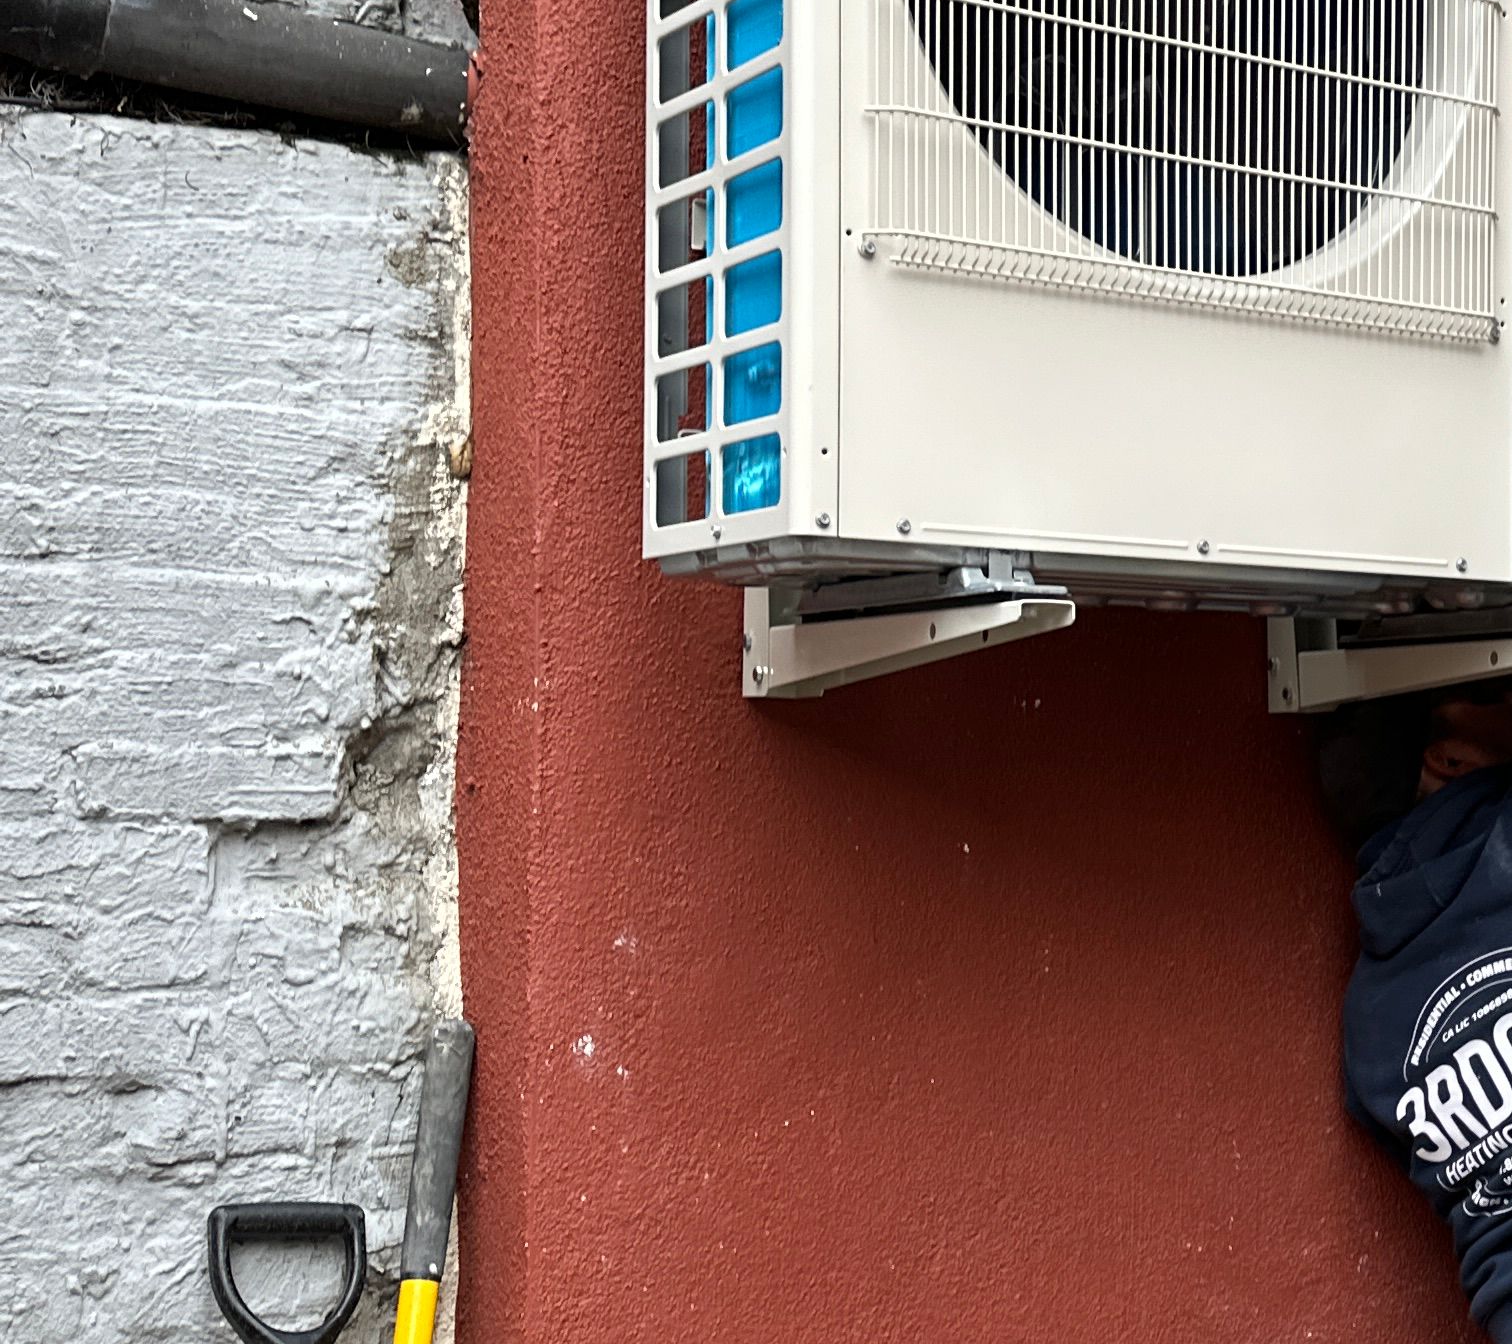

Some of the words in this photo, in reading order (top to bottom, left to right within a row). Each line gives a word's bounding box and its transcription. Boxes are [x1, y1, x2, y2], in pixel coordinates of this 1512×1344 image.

[1411, 986, 1460, 1066] RESIDENTIAL
[1442, 1027, 1455, 1043] CA
[1455, 1016, 1470, 1034] LIC
